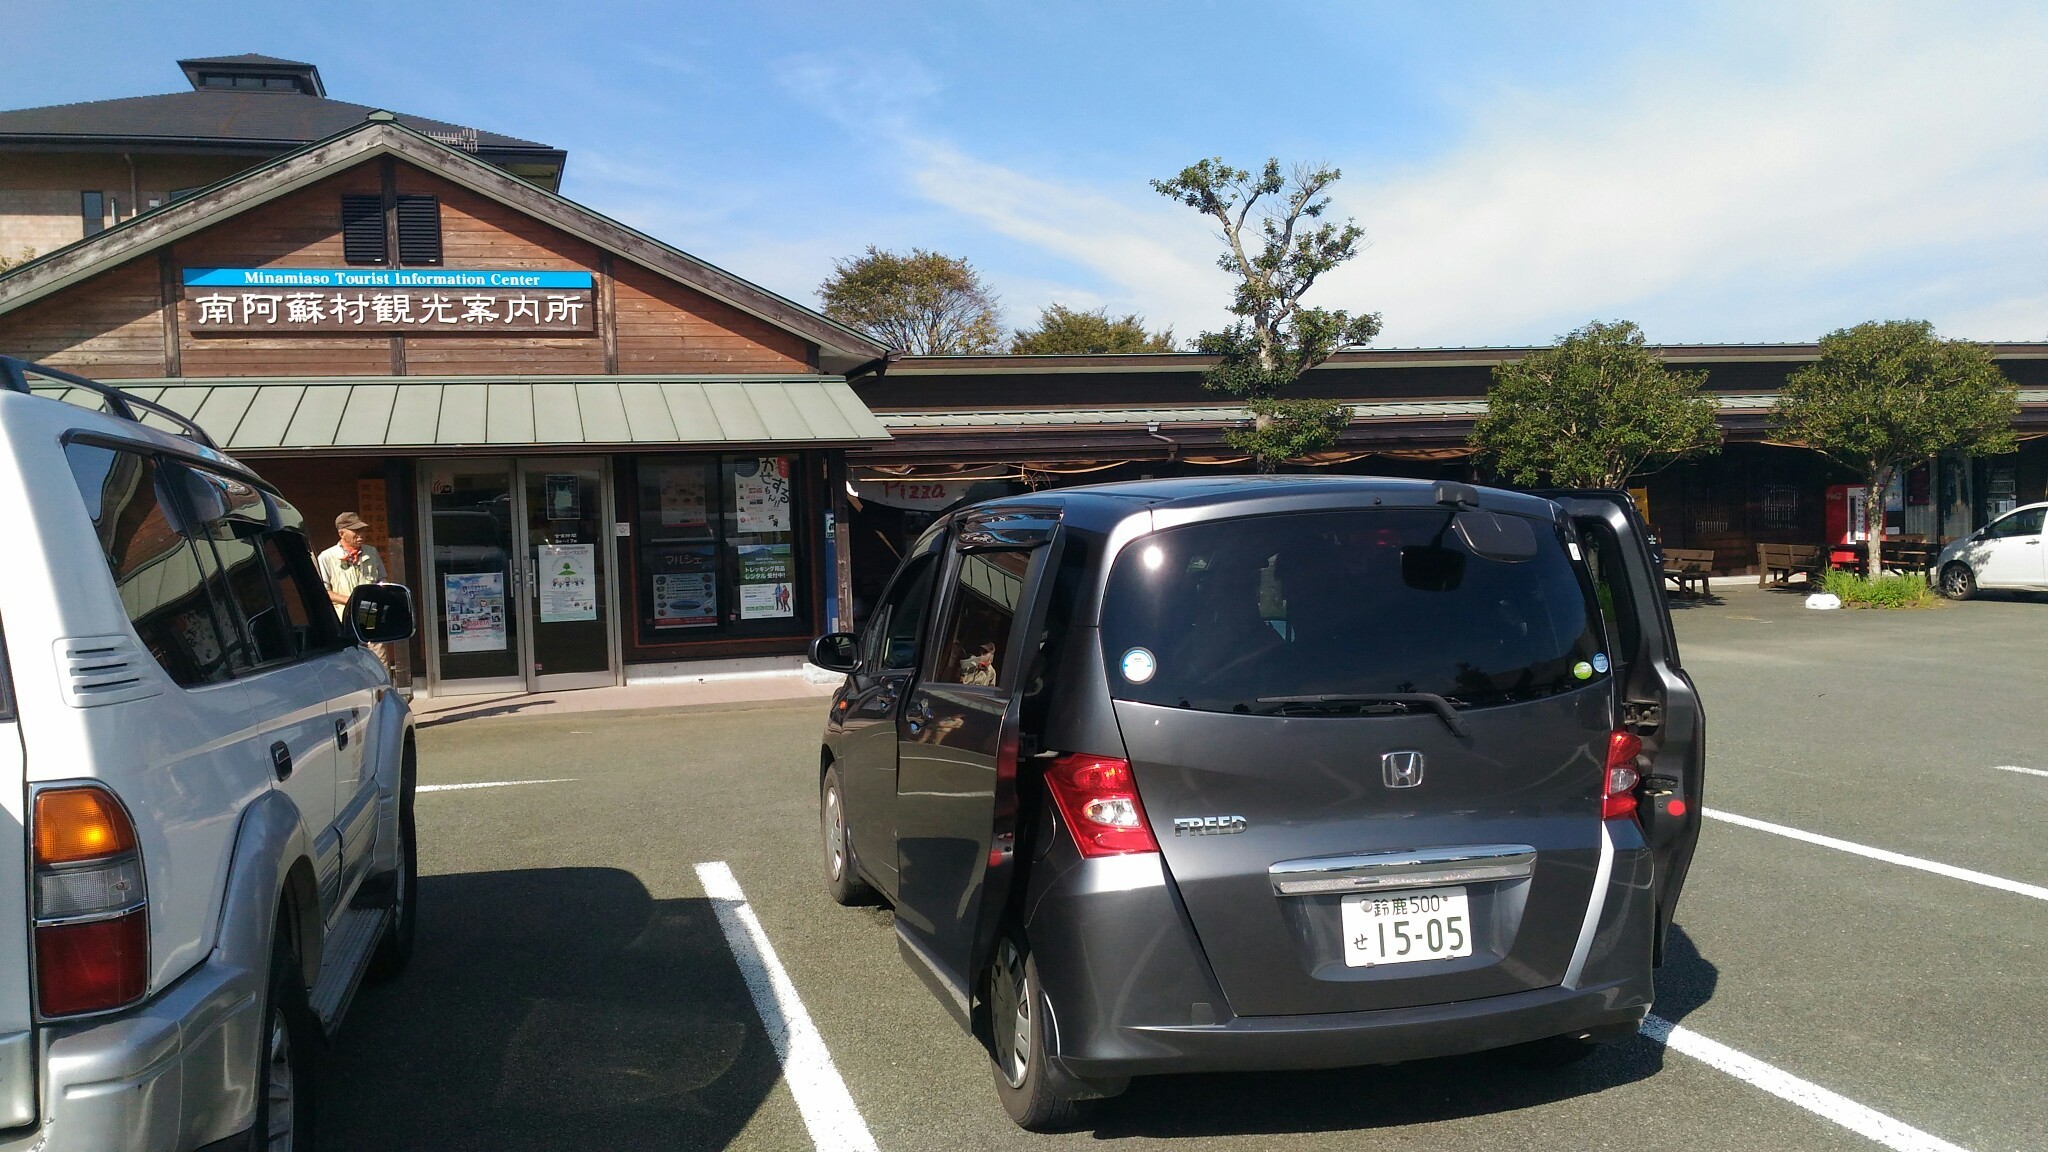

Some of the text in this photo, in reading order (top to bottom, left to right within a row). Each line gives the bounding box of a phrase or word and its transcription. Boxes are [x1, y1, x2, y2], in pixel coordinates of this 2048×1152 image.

[244, 272, 541, 287] Minamiaso Tourist Information Center
[194, 292, 585, 326] 南阿蘇村観光案内所
[882, 479, 946, 500] Pizza
[1174, 815, 1248, 837] FREED
[1353, 916, 1464, 958] せ 15-05
